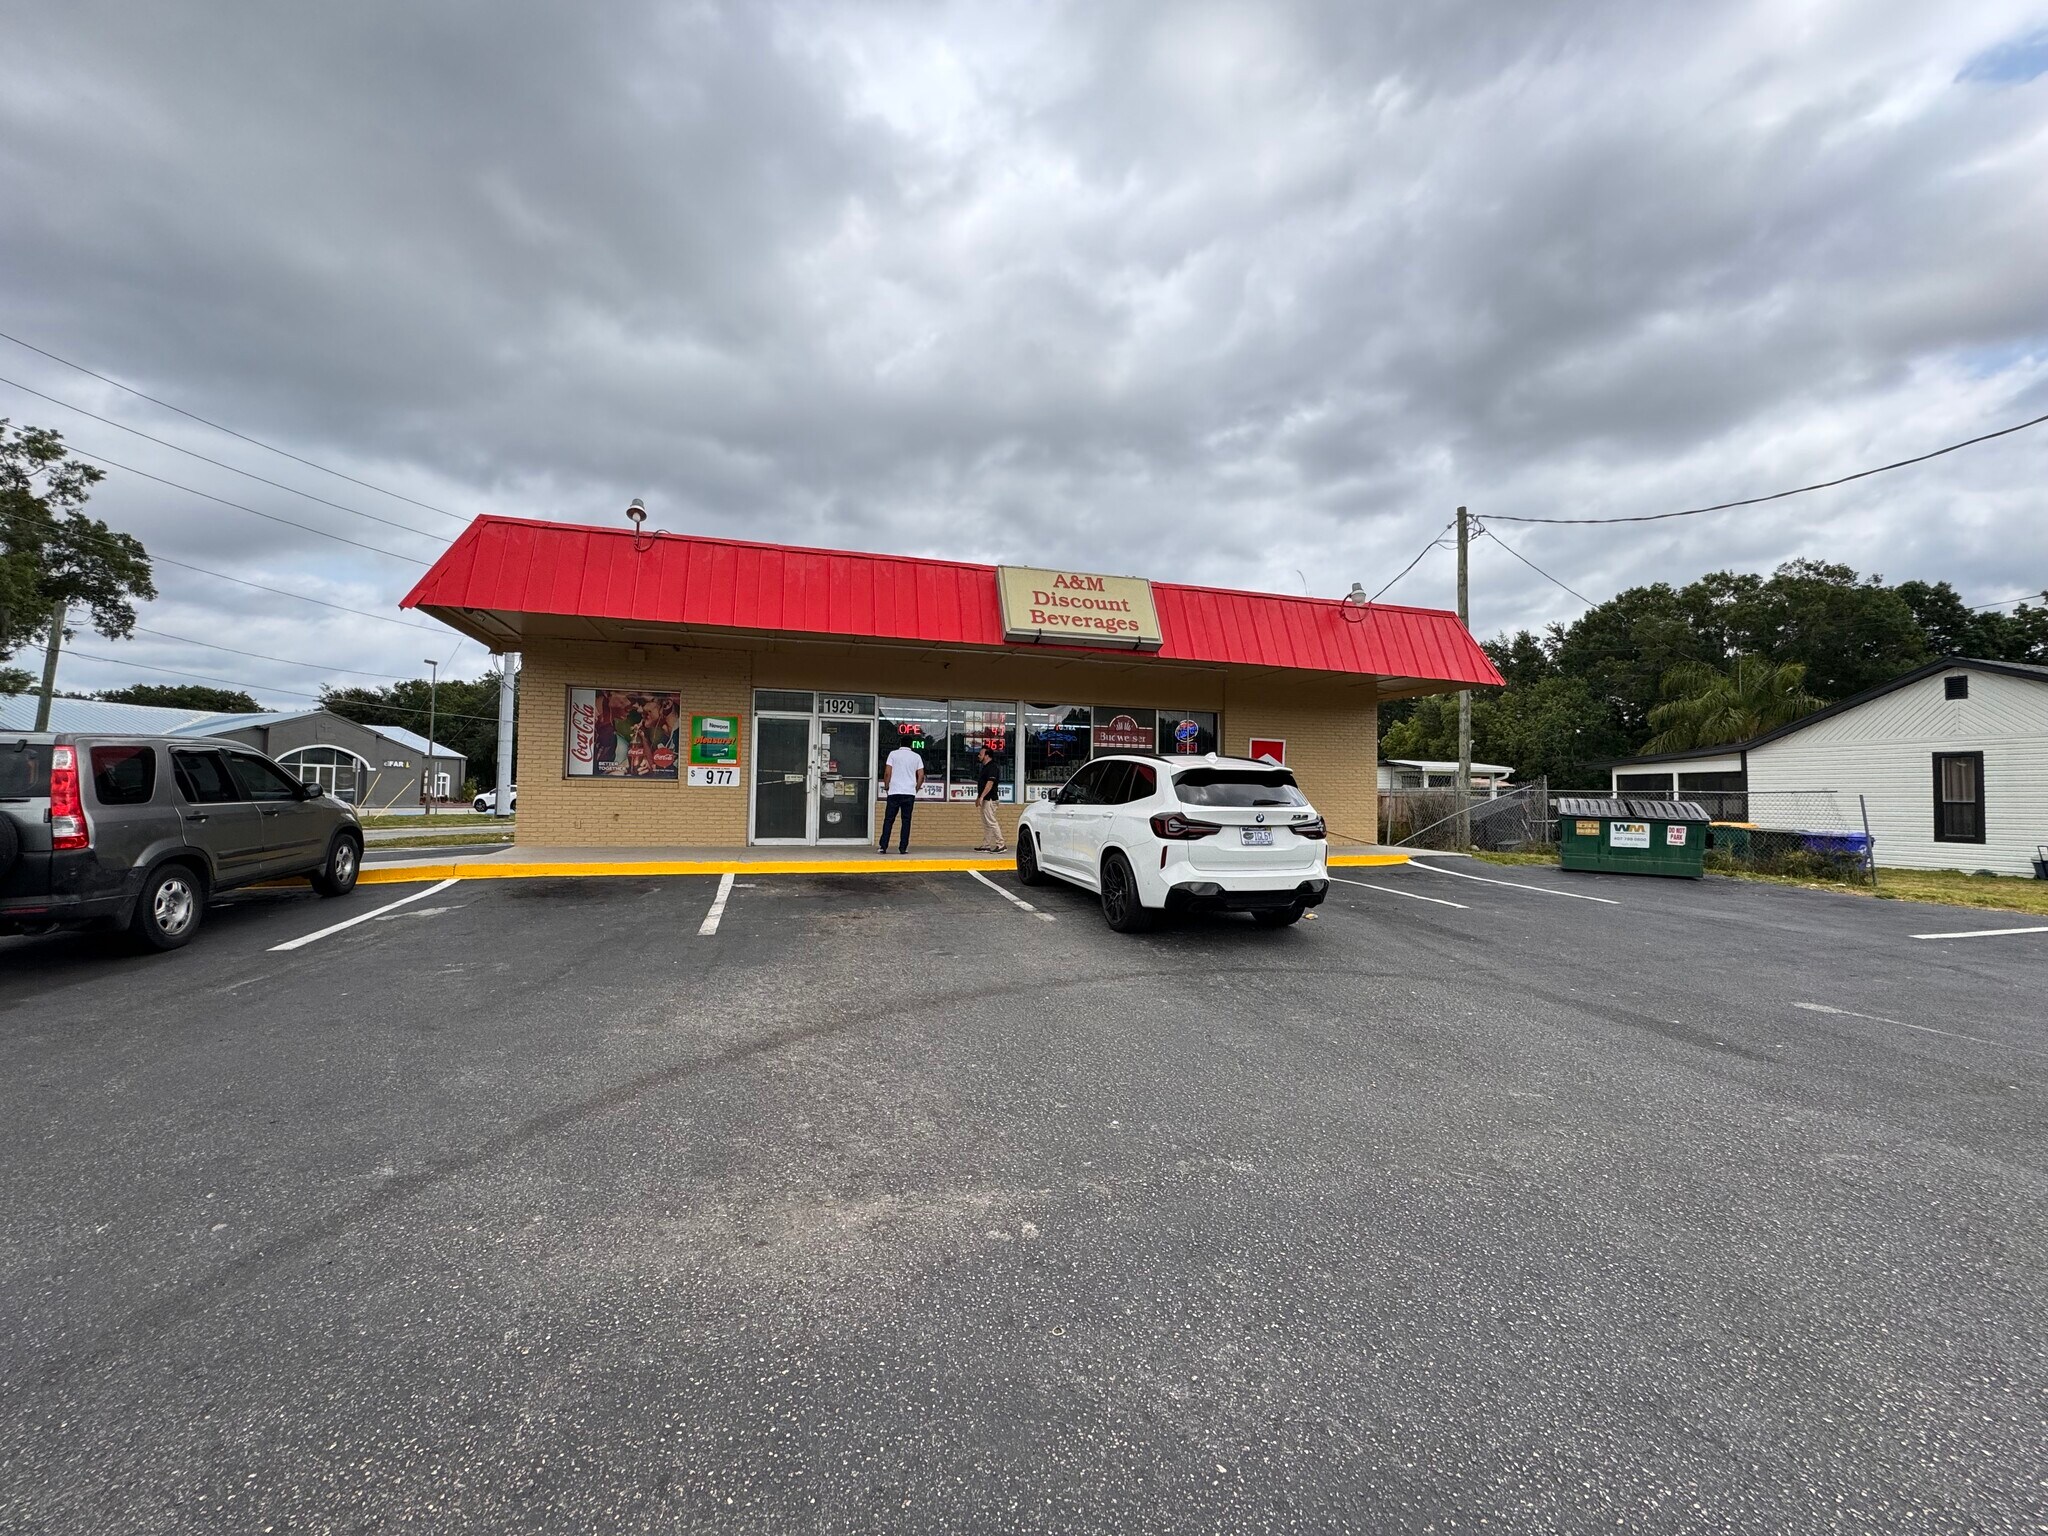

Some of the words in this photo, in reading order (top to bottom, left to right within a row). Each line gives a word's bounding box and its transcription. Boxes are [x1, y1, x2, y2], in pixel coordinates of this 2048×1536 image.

[1053, 574, 1105, 592] A&M
[1032, 590, 1131, 612] Discount
[1029, 609, 1139, 634] Beverages
[825, 699, 854, 714] 1929
[709, 722, 729, 730] Newport
[1100, 731, 1147, 743] Budweser
[690, 769, 696, 778] $
[706, 770, 733, 785] 9.77
[1613, 823, 1646, 833] WM
